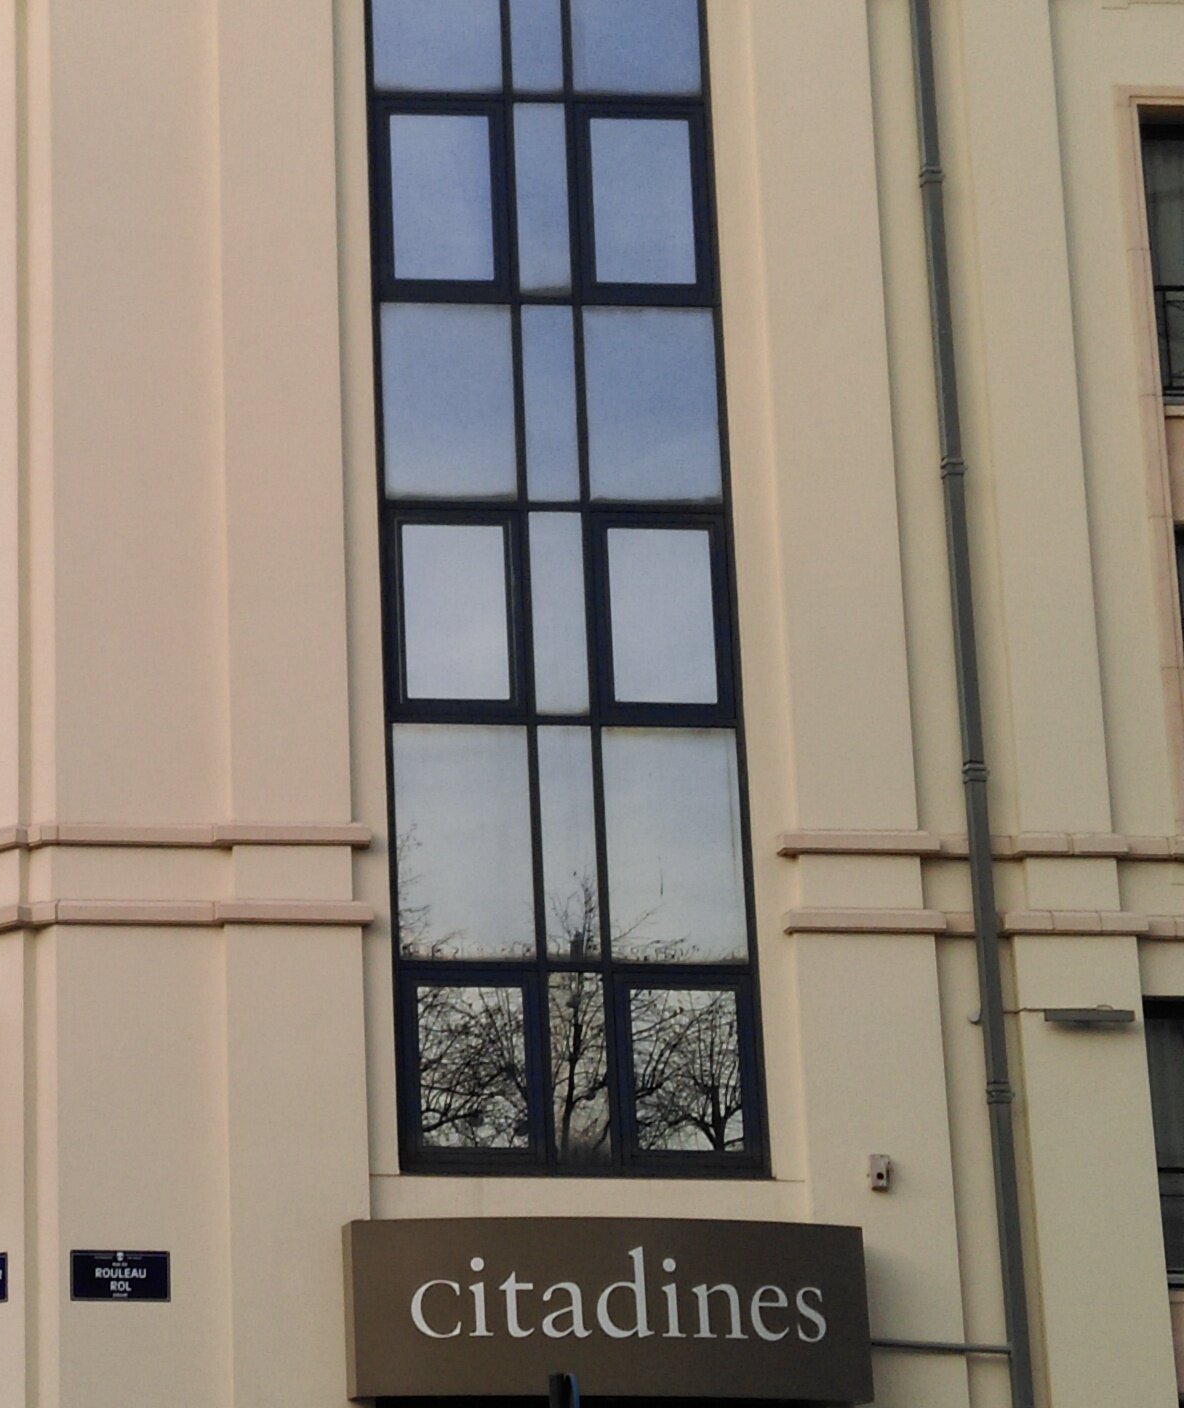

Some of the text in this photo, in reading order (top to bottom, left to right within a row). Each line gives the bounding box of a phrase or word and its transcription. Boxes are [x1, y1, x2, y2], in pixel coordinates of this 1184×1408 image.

[95, 1267, 147, 1279] ROULEAU
[110, 1281, 132, 1292] ROL
[410, 1245, 828, 1343] citadines
